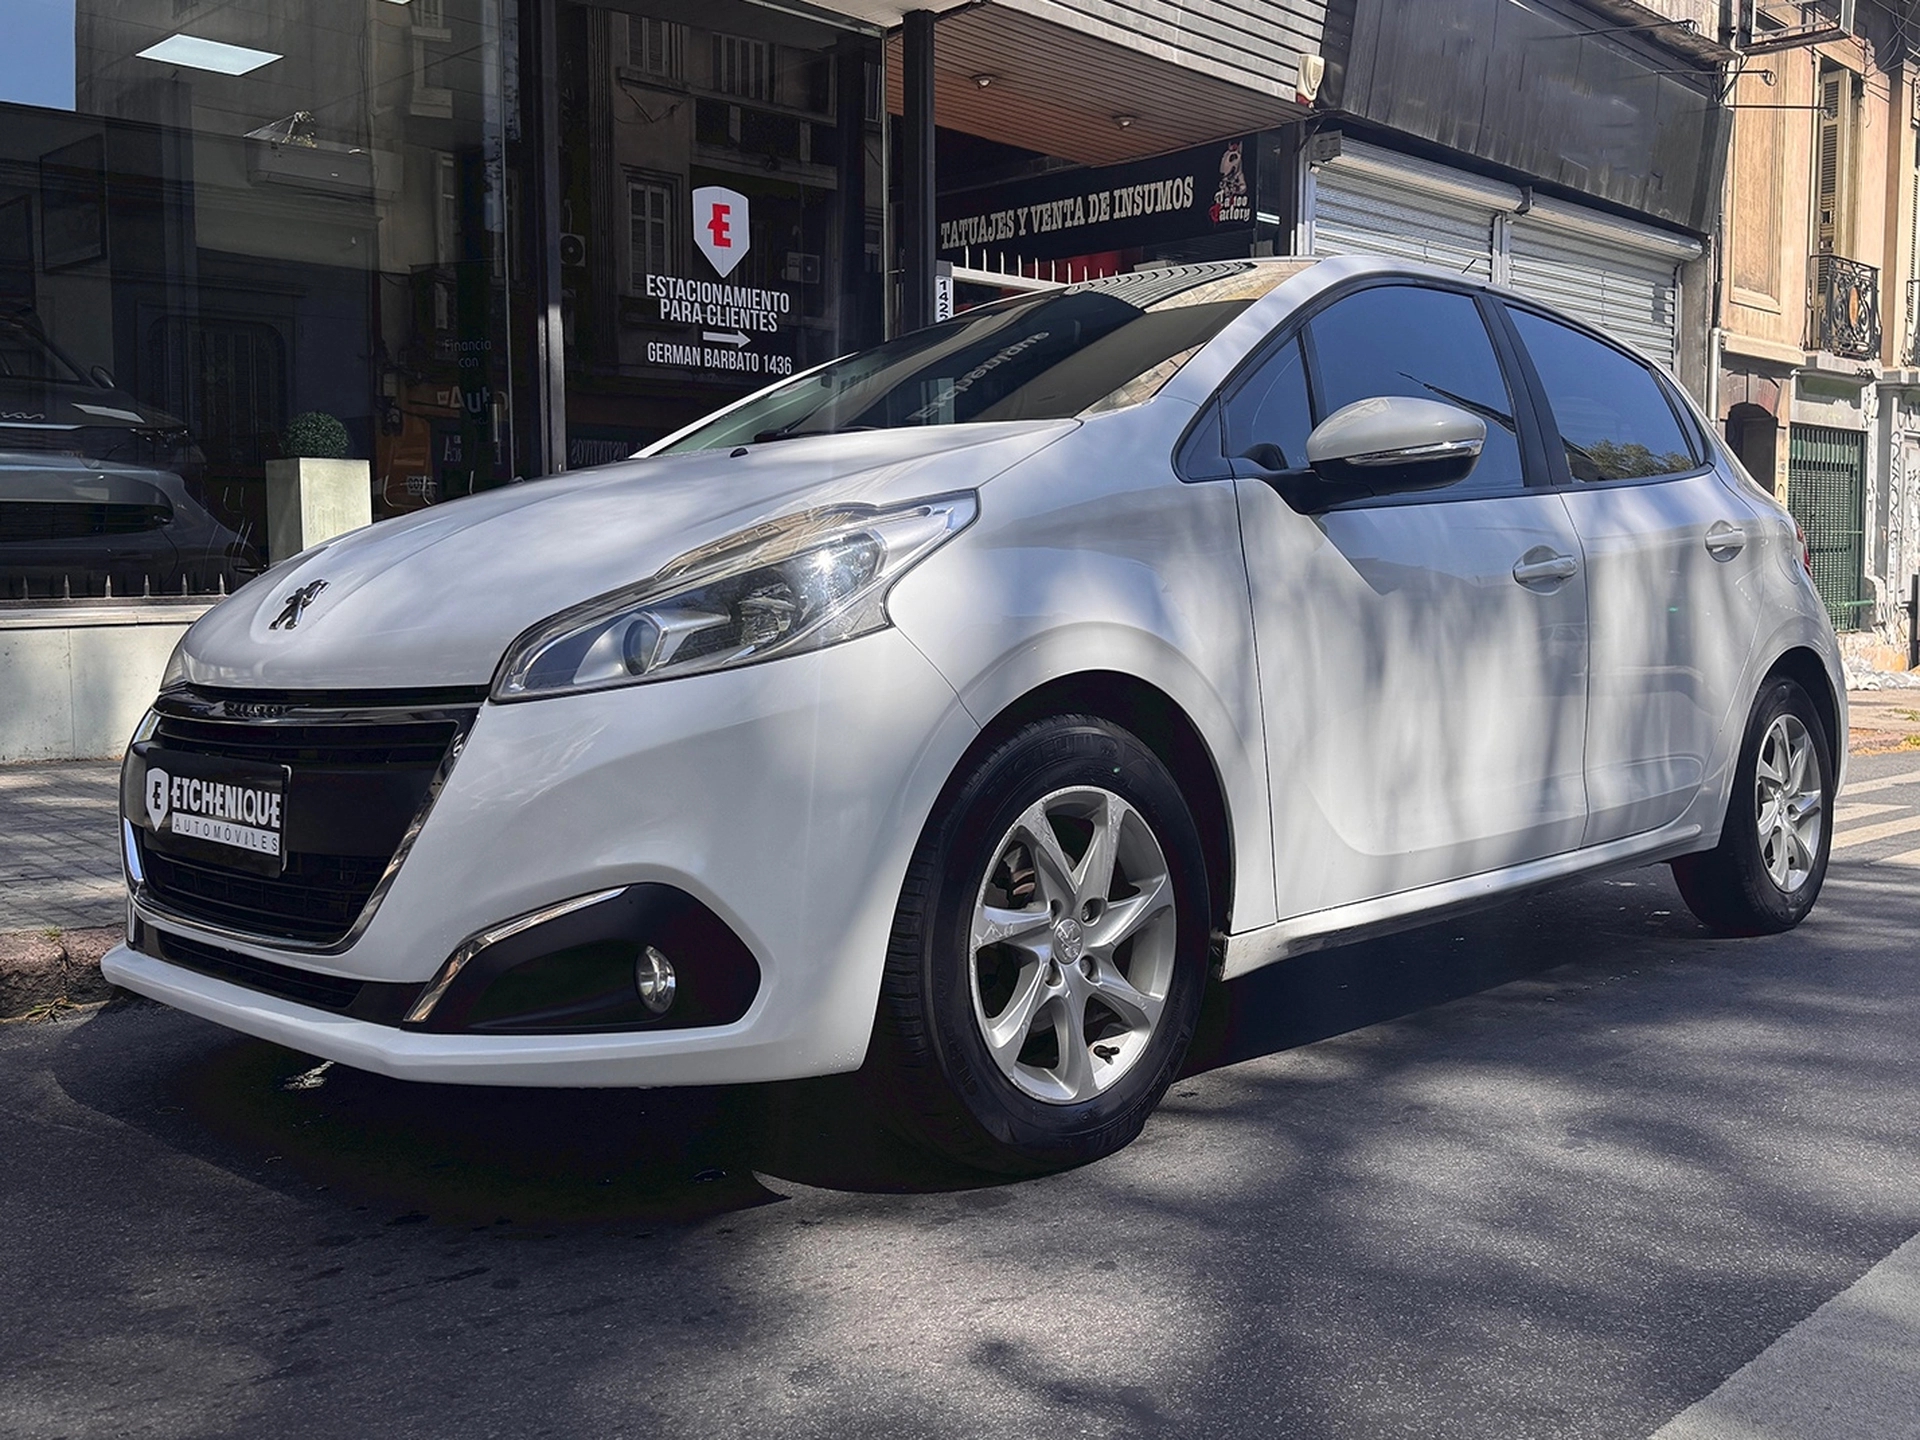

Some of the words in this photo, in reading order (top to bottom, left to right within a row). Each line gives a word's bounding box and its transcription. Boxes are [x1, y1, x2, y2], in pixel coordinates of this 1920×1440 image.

[941, 209, 1015, 249] TATUAJES
[1018, 206, 1028, 236] Y
[1030, 196, 1085, 234] VENTA
[1088, 191, 1110, 223] DE
[1113, 176, 1194, 219] INSUMOS
[646, 274, 790, 313] ESTACIONAMIENTO
[660, 299, 702, 324] PARA
[707, 304, 778, 332] CLIENTES
[458, 356, 479, 368] con
[647, 342, 700, 366] GERMAN
[704, 348, 759, 372] BARBATO
[763, 355, 792, 375] 1436
[170, 776, 282, 828] ETCHENIQUE
[174, 818, 279, 852] AUTOMÓVILES
